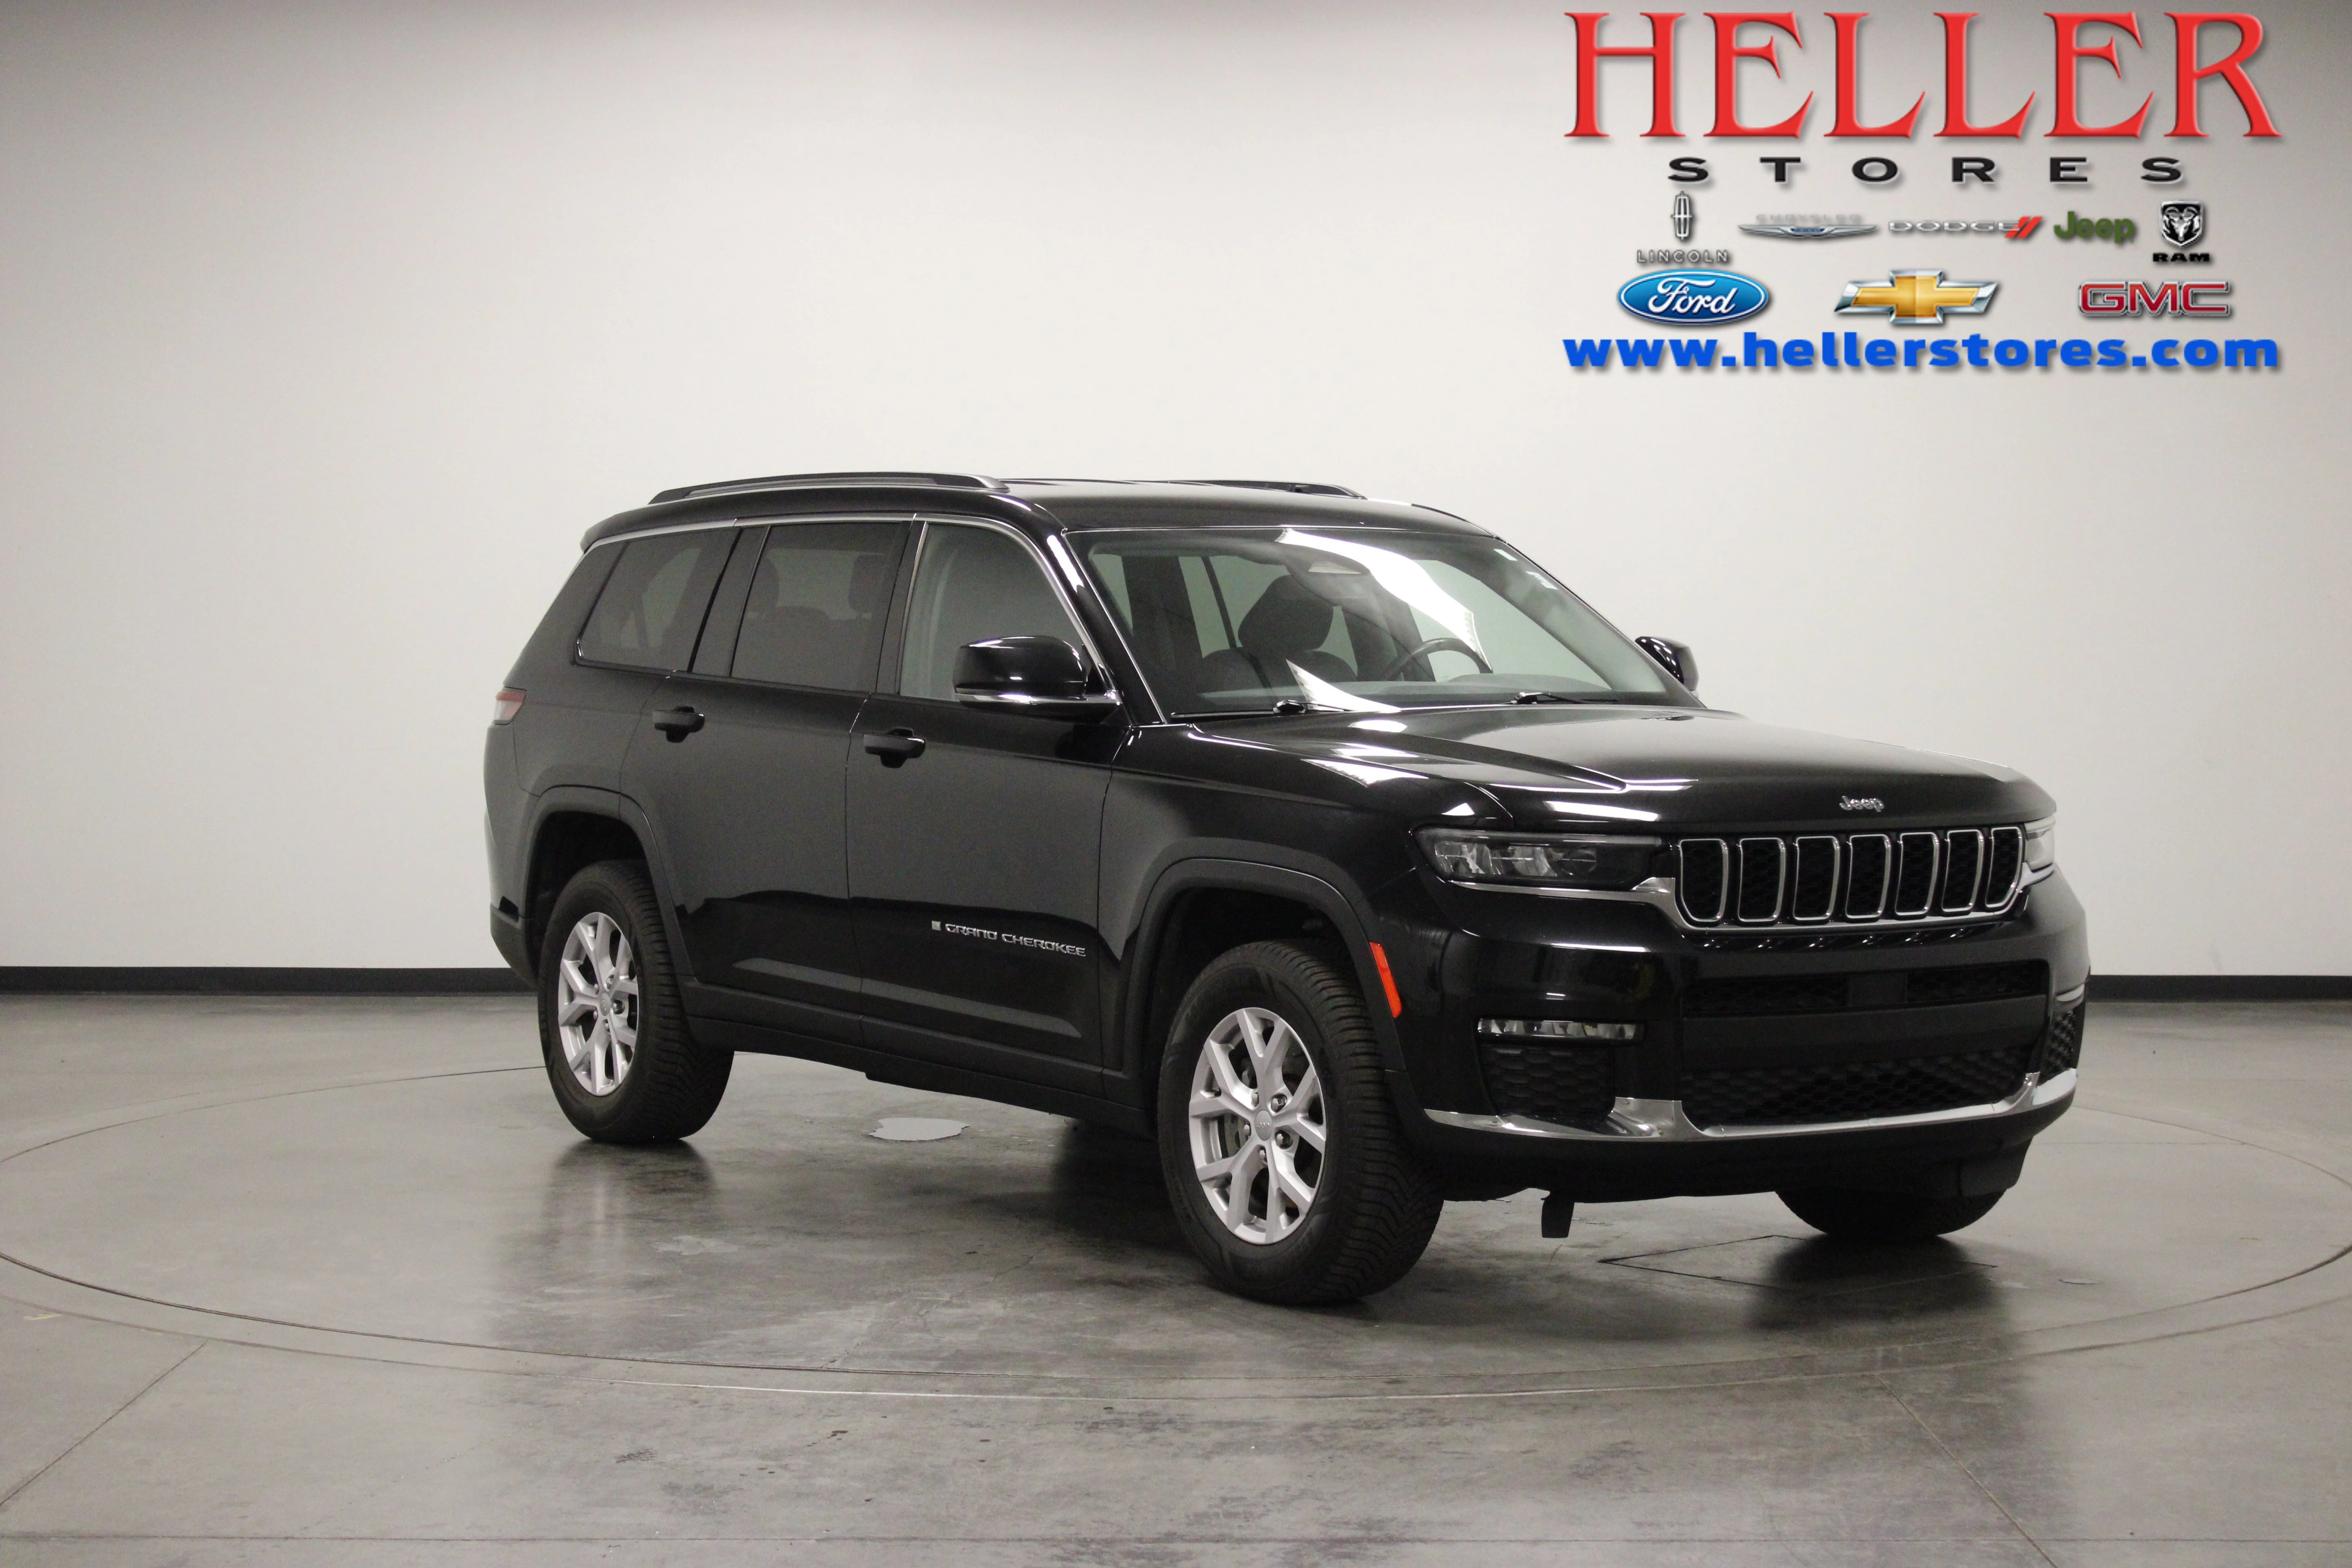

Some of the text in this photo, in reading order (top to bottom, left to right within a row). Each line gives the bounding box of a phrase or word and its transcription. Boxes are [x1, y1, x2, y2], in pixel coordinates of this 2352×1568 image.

[1839, 795, 1884, 812] Jeep
[945, 923, 1086, 957] GRAND CHEROKEE
